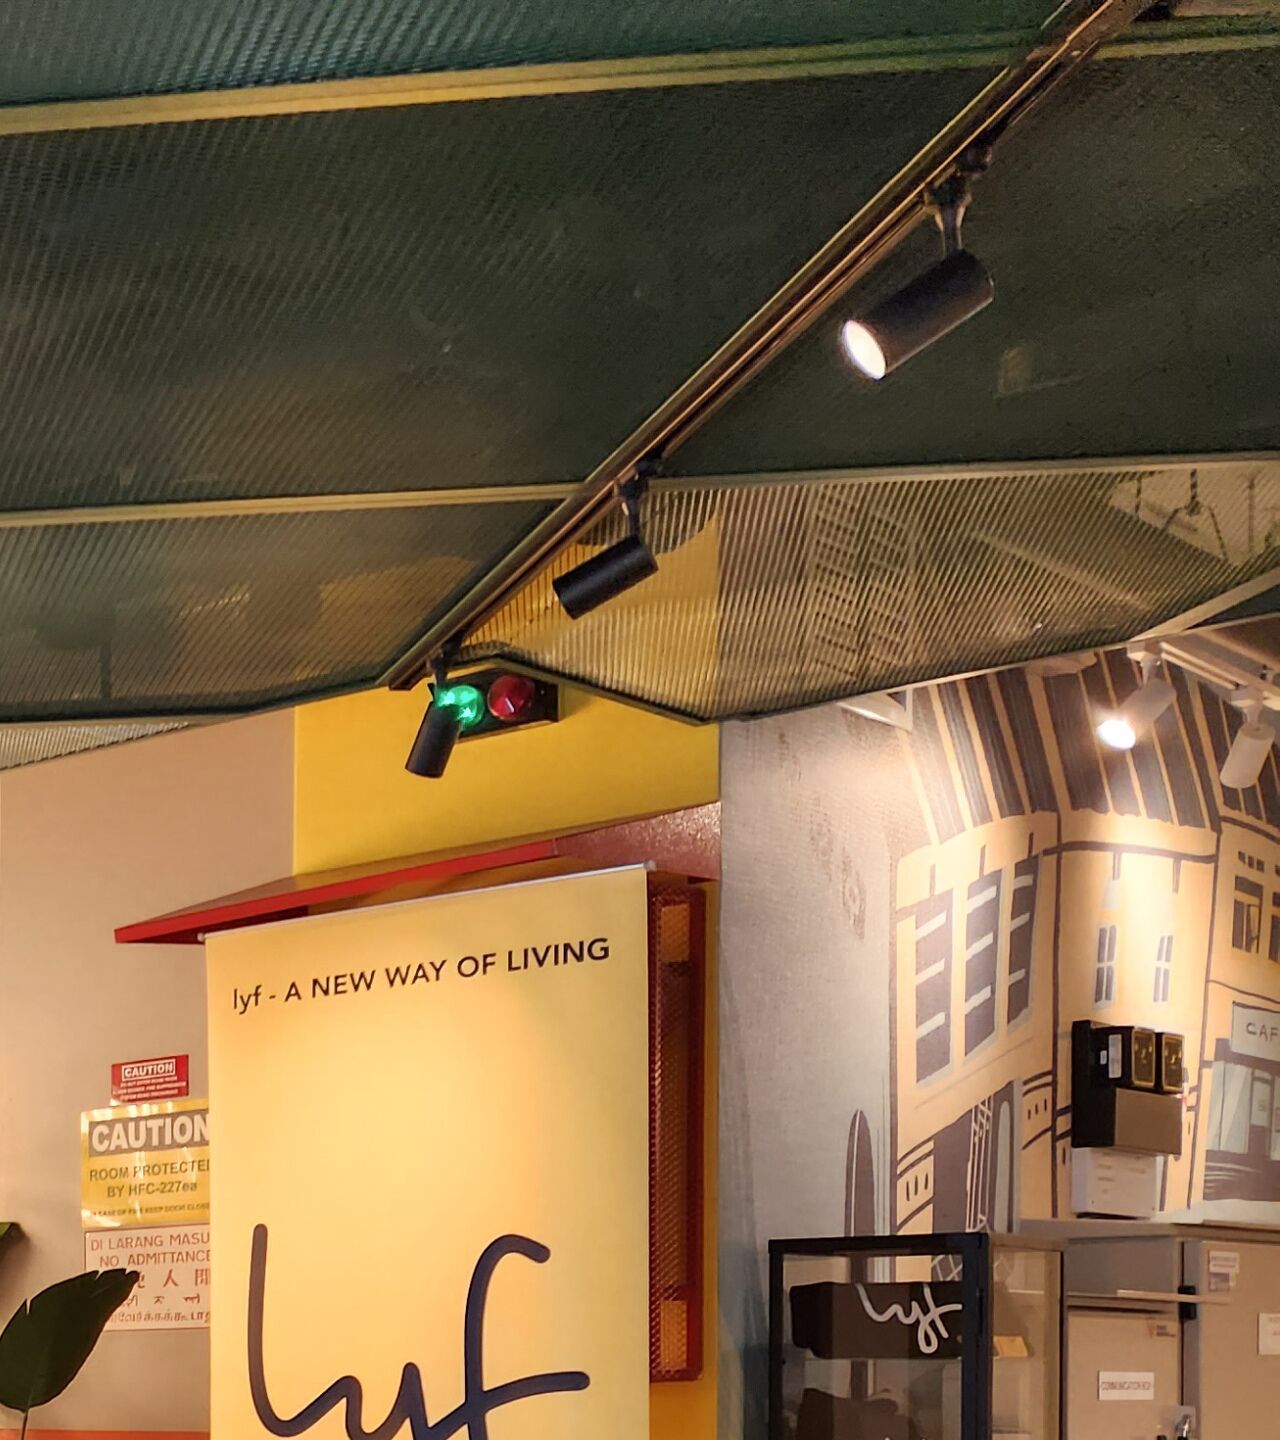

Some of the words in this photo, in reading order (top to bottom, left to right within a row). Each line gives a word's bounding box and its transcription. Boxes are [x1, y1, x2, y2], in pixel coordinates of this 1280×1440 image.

[233, 986, 263, 1015] lyf
[284, 981, 303, 1002] A
[311, 969, 377, 998] NEW
[384, 959, 448, 988] WAY
[456, 953, 497, 978] OF
[507, 937, 611, 972] LIVING
[124, 1062, 174, 1078] CAUTION
[92, 1116, 209, 1152] CAUTION
[90, 1166, 129, 1181] ROOM
[107, 1185, 125, 1198] BY
[128, 1180, 197, 1196] HFC-227ea
[90, 1239, 103, 1251] DI
[108, 1236, 164, 1250] LARANG
[169, 1232, 210, 1246] MASU
[100, 1256, 120, 1268] NO
[127, 1250, 210, 1266] ADMITTANCE
